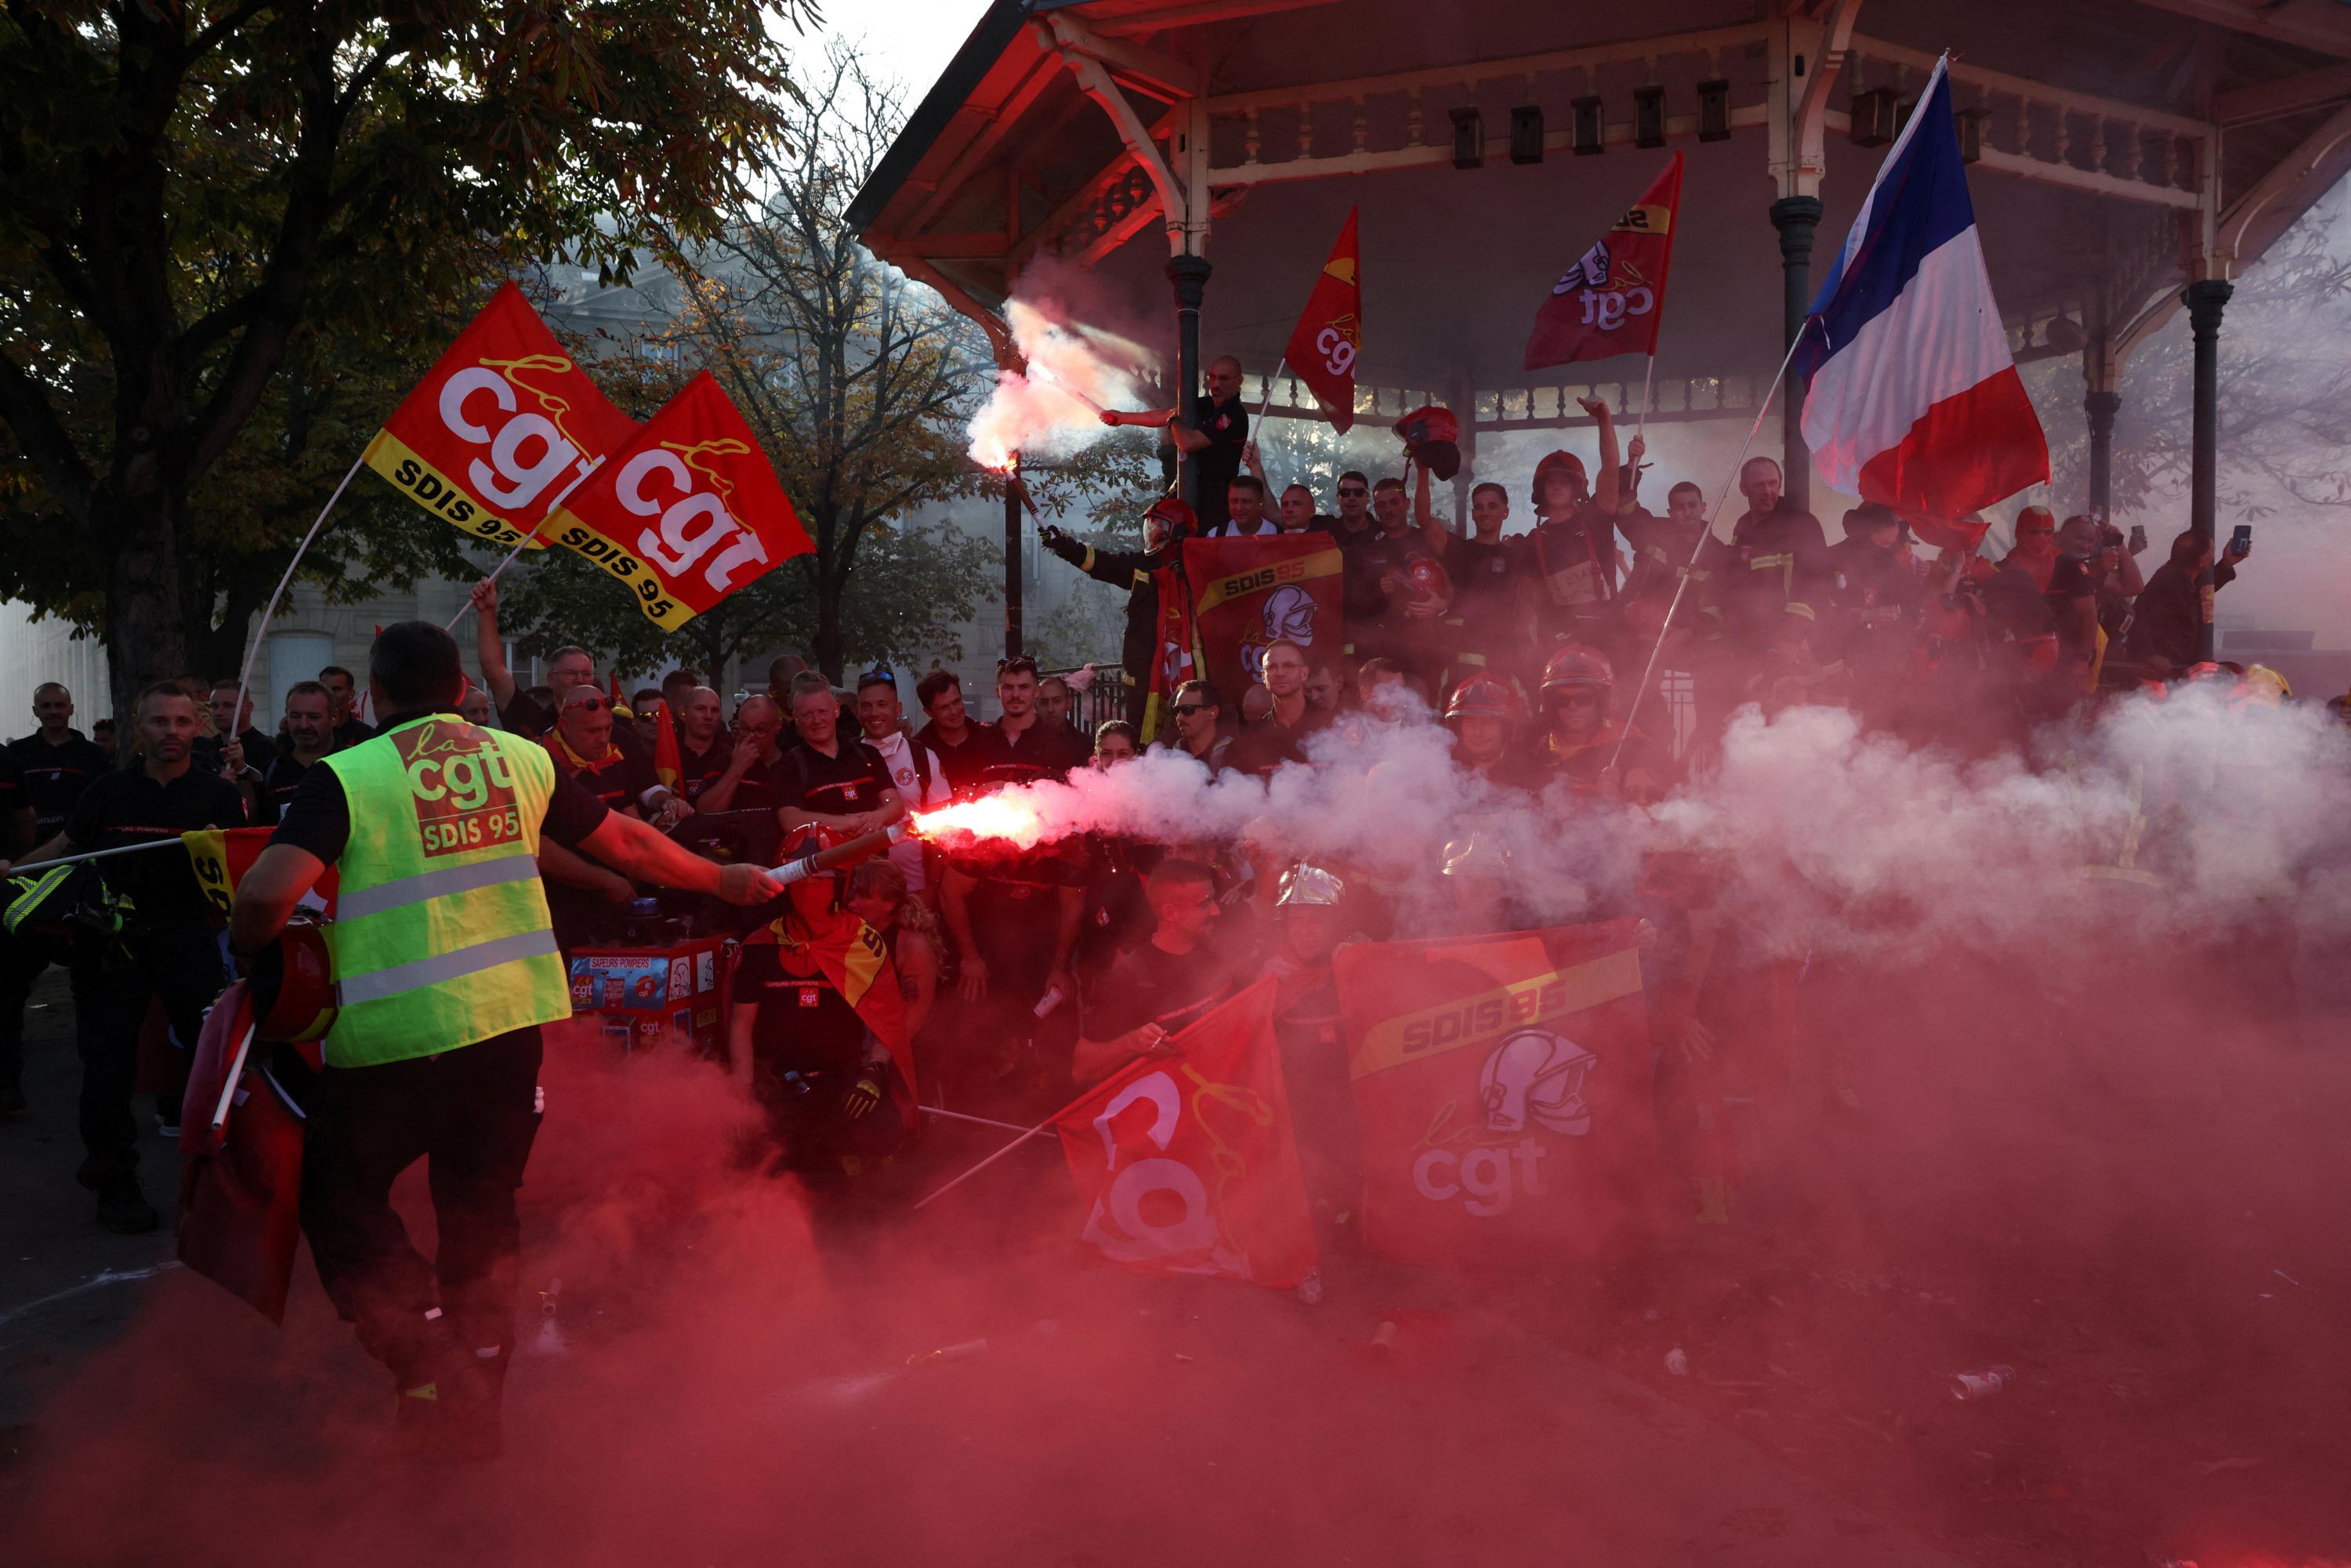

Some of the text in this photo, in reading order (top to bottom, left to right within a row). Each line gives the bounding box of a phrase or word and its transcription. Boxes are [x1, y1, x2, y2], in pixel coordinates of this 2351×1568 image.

[1317, 328, 1355, 376] cg
[439, 366, 606, 515] cgt
[394, 458, 523, 545] SDIS 95
[615, 448, 769, 593] cgt
[560, 527, 672, 619] SDIS 95
[1224, 560, 1305, 596] SDIS 95
[1241, 644, 1265, 684] cg
[407, 723, 499, 761] la
[407, 741, 513, 810] cgt
[423, 812, 520, 851] SDIS 95
[195, 856, 231, 918] SD
[573, 982, 593, 998] cgt
[592, 958, 649, 968] SAPEURS POMPIERS
[801, 993, 817, 1003] cgt
[1403, 980, 1567, 1054] SDIS 95
[640, 1021, 660, 1035] cgt
[1081, 1070, 1254, 1279] cg
[1414, 1136, 1549, 1217] cgt
